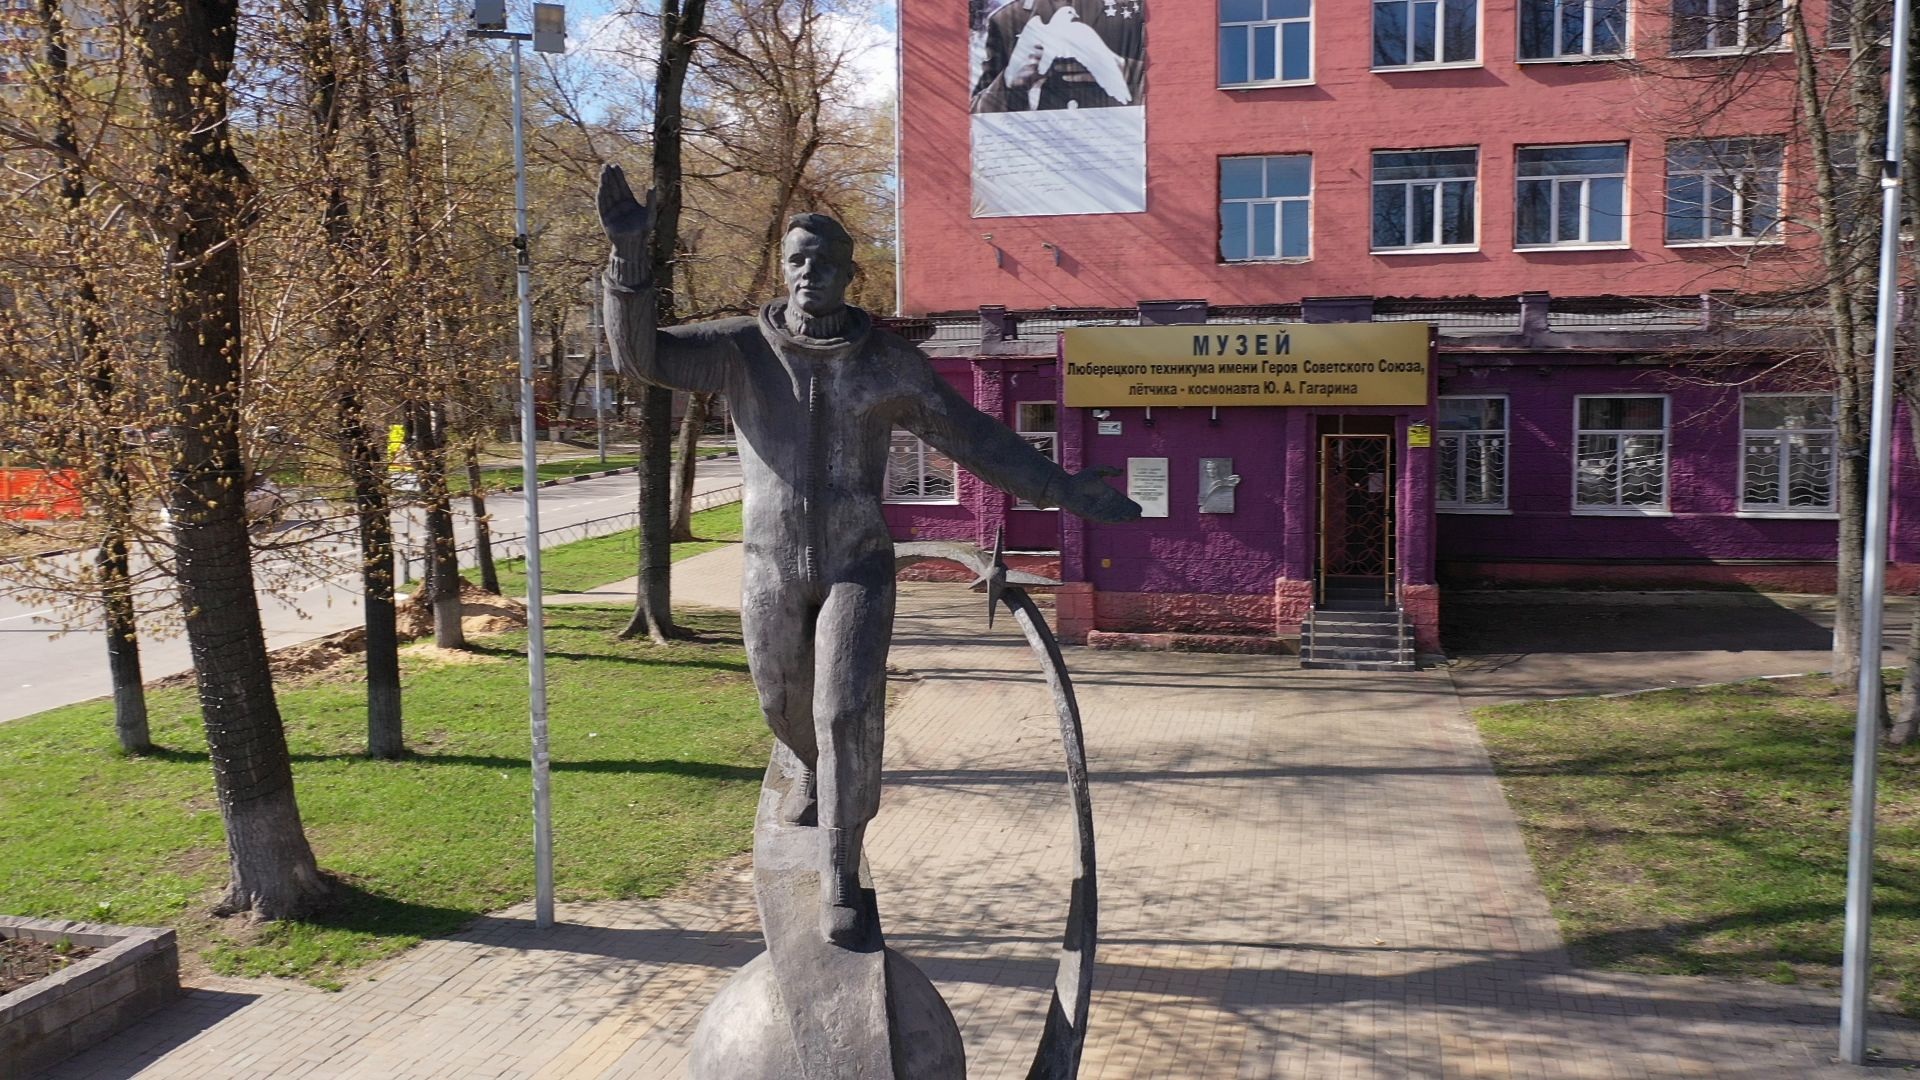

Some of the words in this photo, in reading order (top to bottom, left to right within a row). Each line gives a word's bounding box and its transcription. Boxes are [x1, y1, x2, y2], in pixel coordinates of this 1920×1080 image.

[1193, 330, 1290, 356] МУЗЕЙ
[1067, 362, 1147, 378] Люберецкого
[1150, 363, 1215, 377] техникума
[1218, 363, 1258, 375] имени
[1261, 360, 1298, 376] Героя
[1303, 359, 1375, 374] Советского
[1378, 358, 1425, 375] Союза,
[1128, 382, 1177, 396] лётчика
[1188, 384, 1260, 396] космонавта
[1263, 380, 1280, 395] Ю.
[1283, 380, 1296, 395] А.
[1299, 380, 1358, 397] Гагарина
